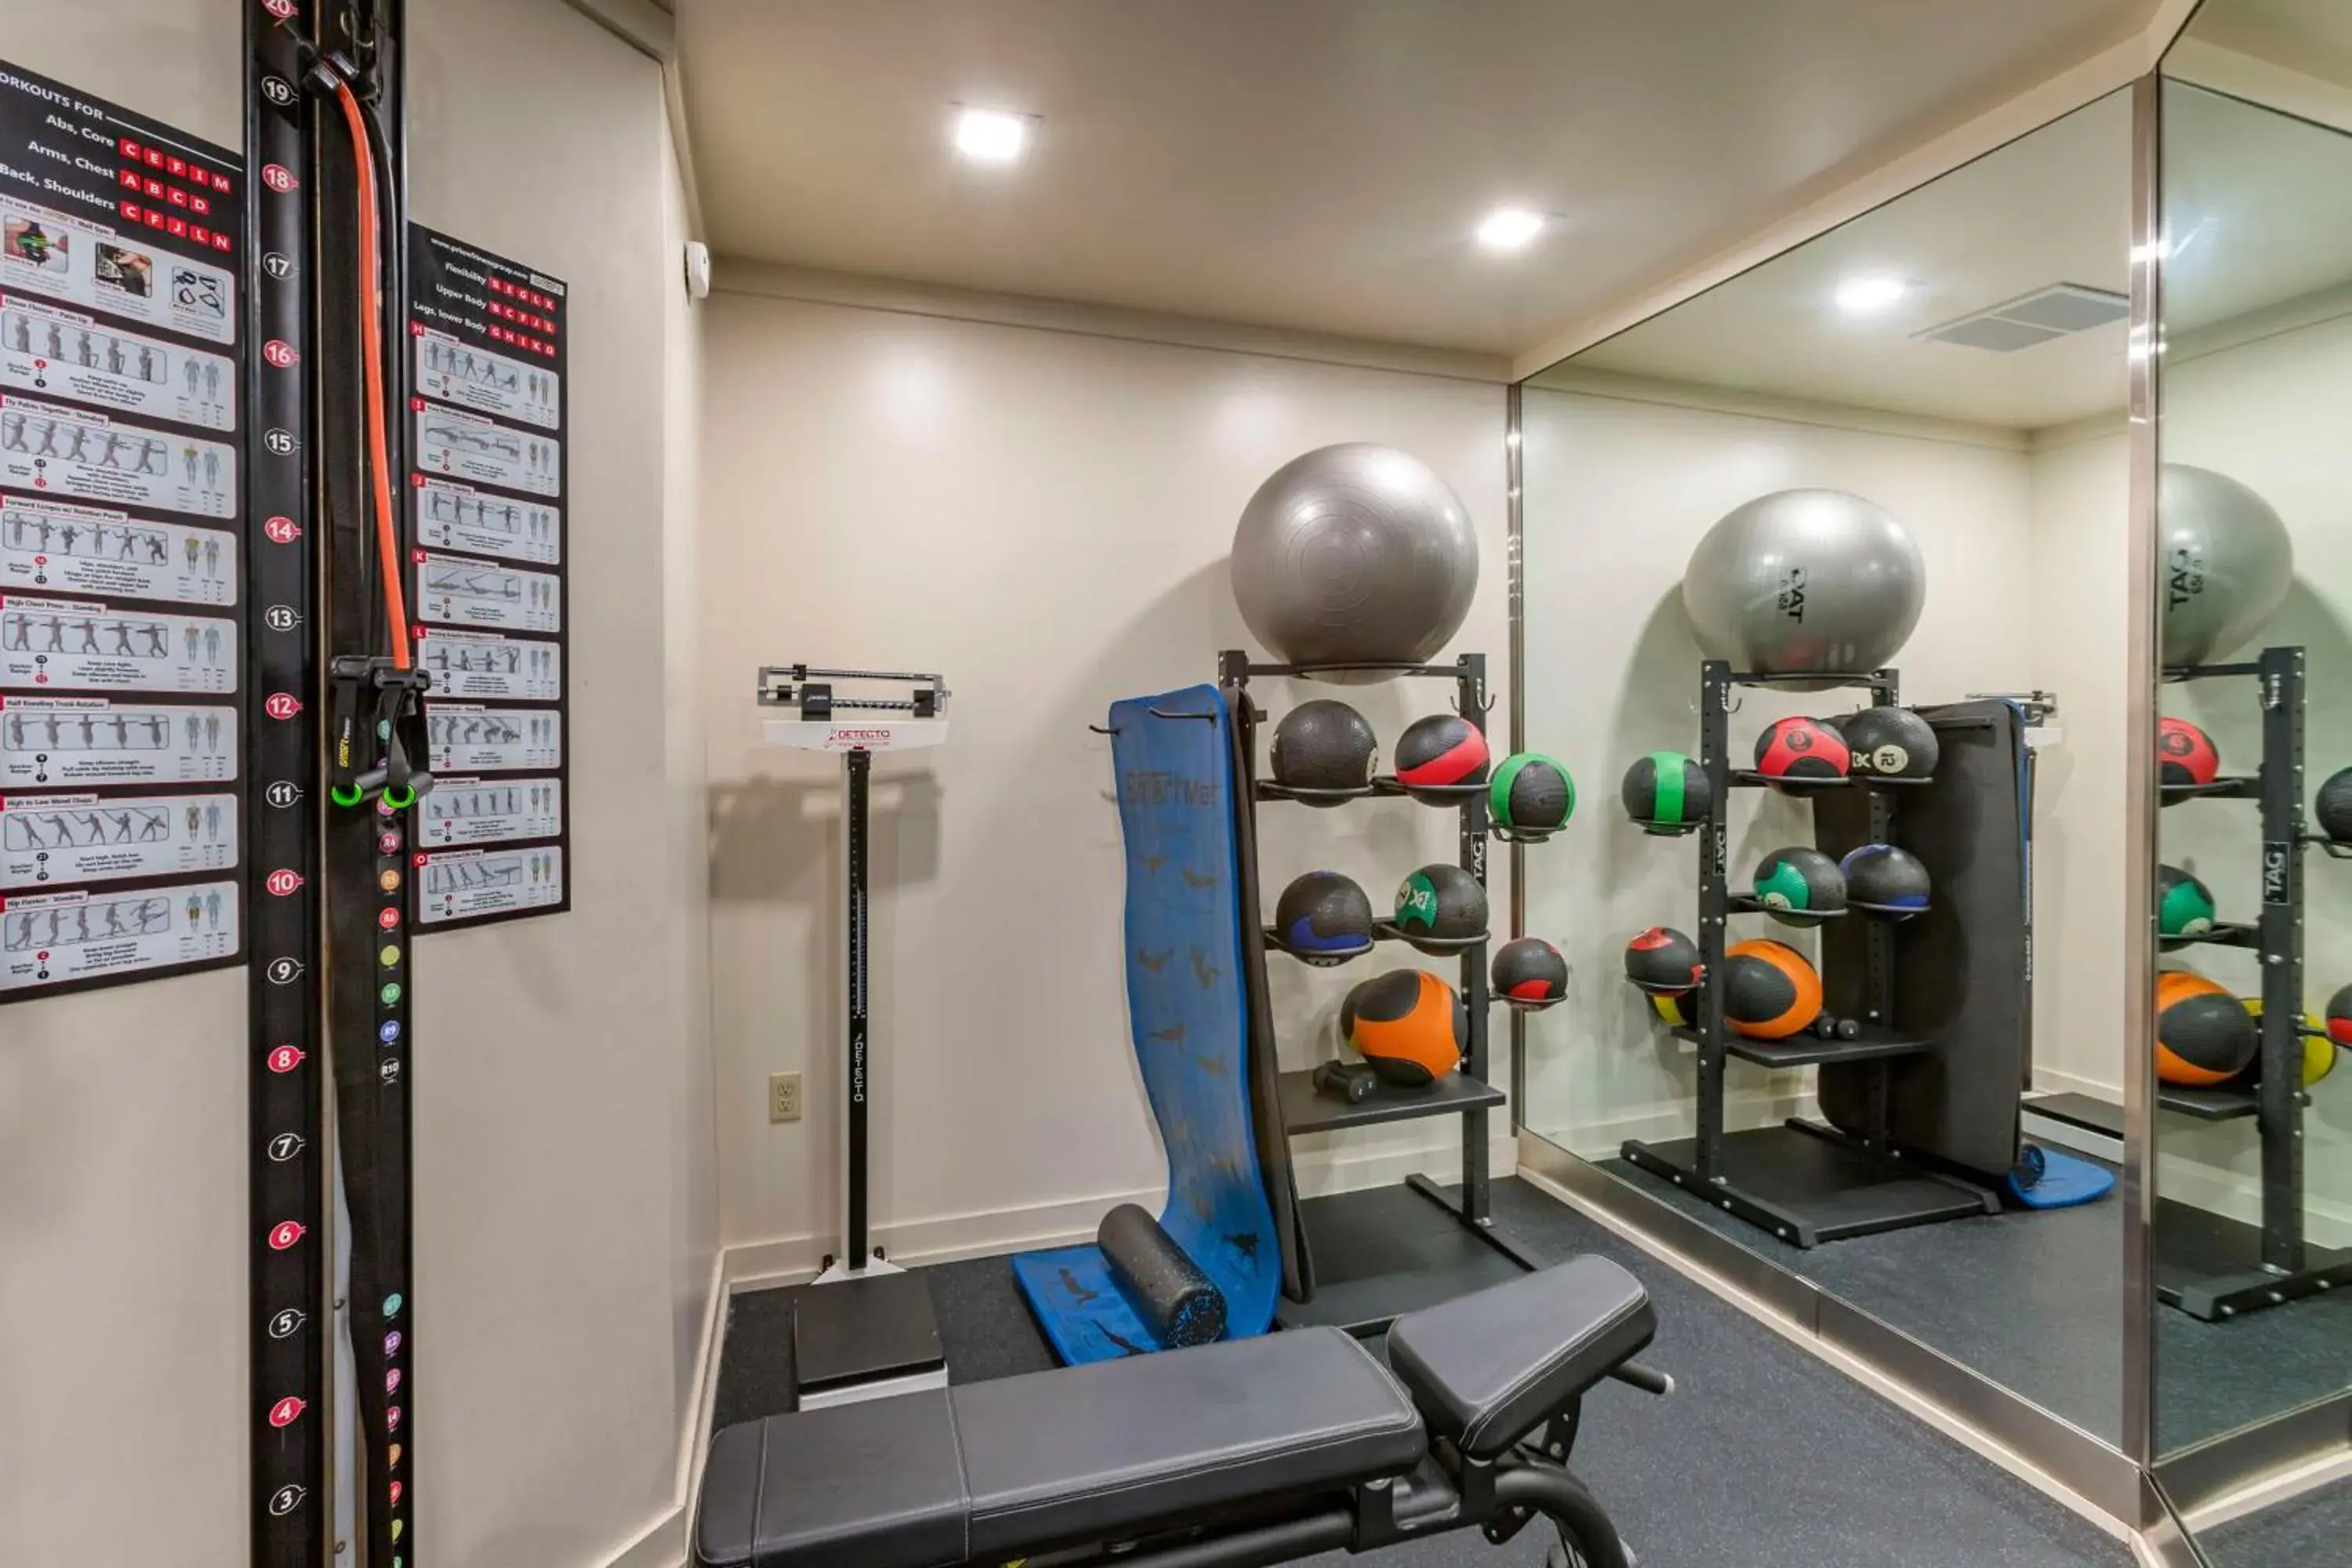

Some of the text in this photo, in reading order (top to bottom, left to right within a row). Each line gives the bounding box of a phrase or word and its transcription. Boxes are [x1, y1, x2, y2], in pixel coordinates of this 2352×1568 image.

[266, 81, 289, 101] 19
[74, 100, 103, 121] FOR
[81, 127, 115, 147] Core
[74, 157, 115, 180] Chest
[266, 169, 289, 189] 18
[43, 177, 115, 210] Shoulders
[267, 256, 289, 276] 17
[445, 261, 487, 286] Flexibility
[435, 282, 463, 299] Upper
[464, 293, 487, 310] Body
[464, 317, 487, 334] Body
[267, 344, 292, 365] 16
[269, 433, 292, 452] 15
[270, 521, 292, 539] 14
[270, 608, 292, 627] 13
[270, 697, 292, 714] 12
[838, 729, 891, 739] DETECTO
[271, 785, 292, 804] 11
[1472, 840, 1485, 878] TAG
[271, 873, 294, 892] 10
[2264, 851, 2284, 895] TAG
[277, 962, 292, 980] 9
[278, 1050, 291, 1068] 8
[853, 1040, 865, 1103] DETECTO
[278, 1138, 292, 1157] 7
[278, 1226, 292, 1243] 6
[279, 1314, 292, 1334] 5
[278, 1401, 292, 1420] 4
[279, 1490, 293, 1511] 3
